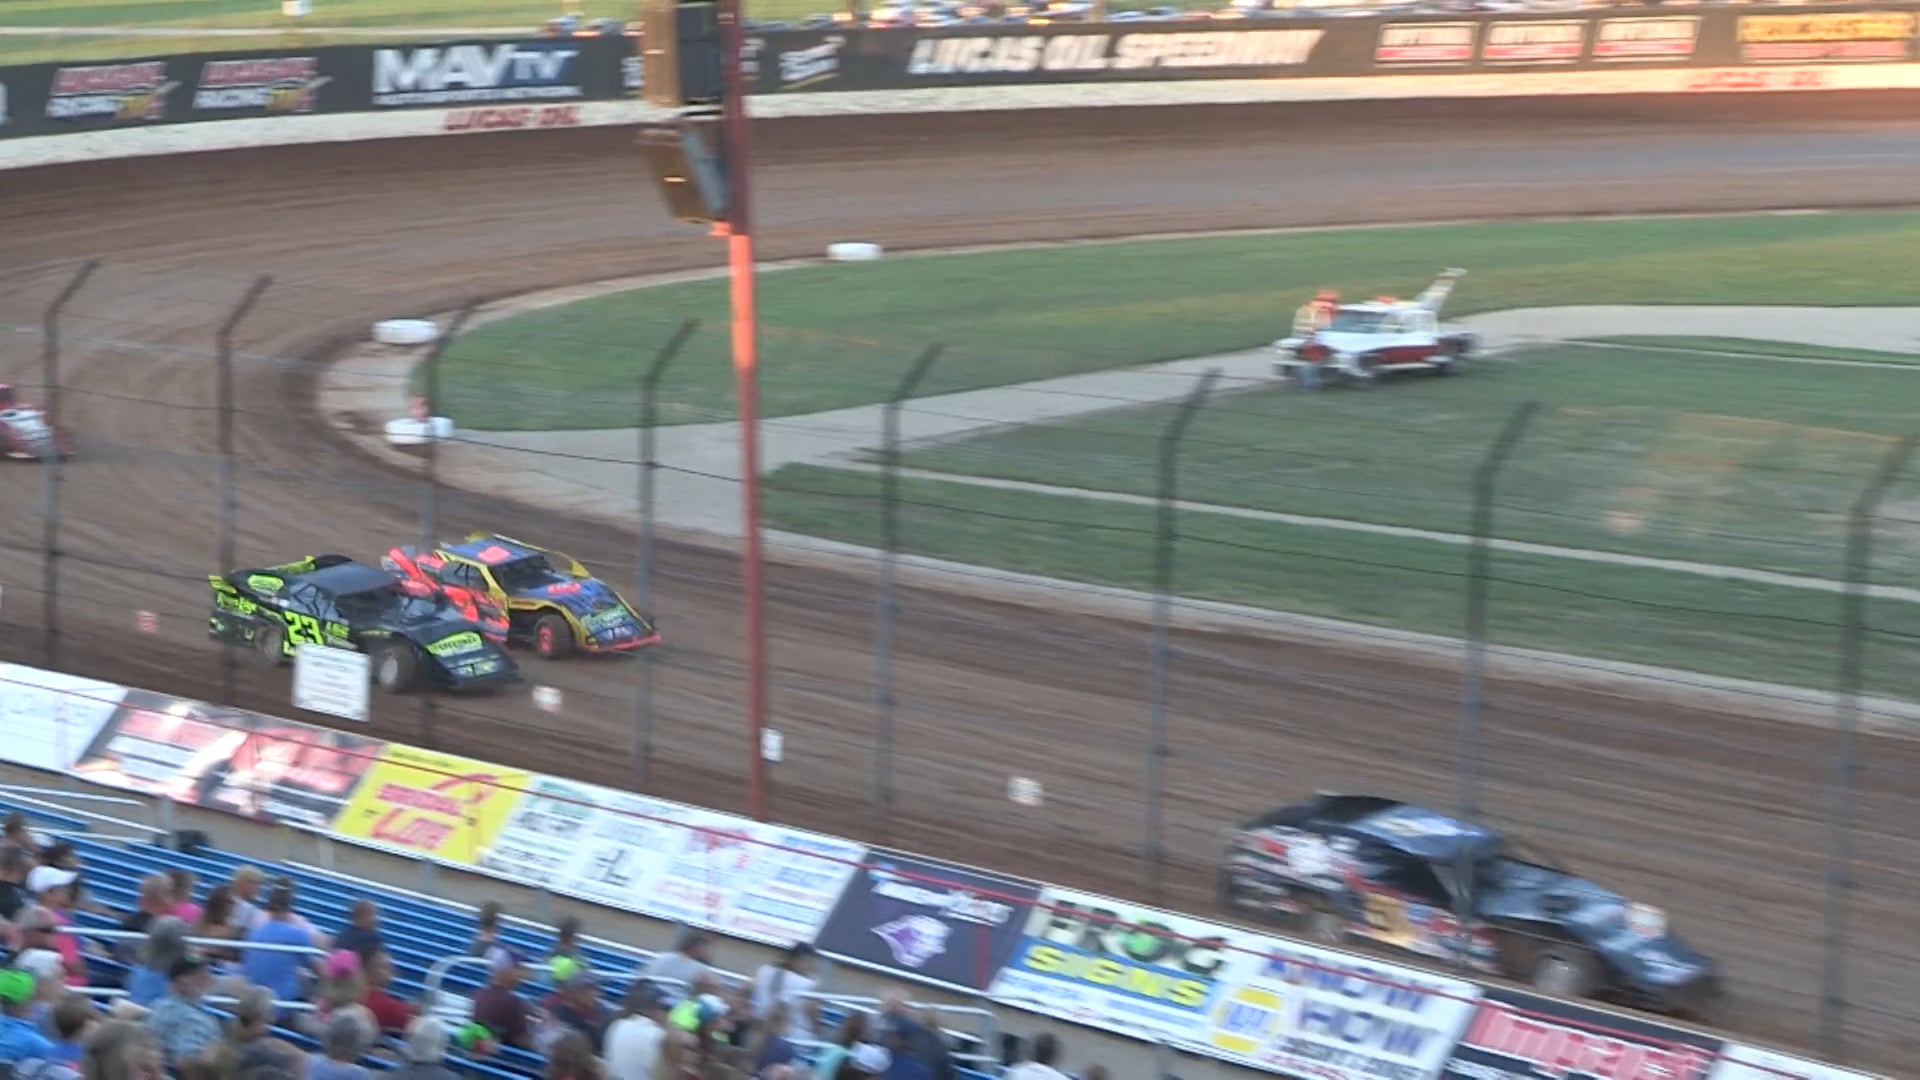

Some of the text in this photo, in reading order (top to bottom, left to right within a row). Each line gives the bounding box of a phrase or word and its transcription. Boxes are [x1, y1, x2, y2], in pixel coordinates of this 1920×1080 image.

[906, 37, 1044, 75] LUCAS
[1042, 35, 1112, 69] OIL
[1021, 944, 1210, 1008] SIGNS
